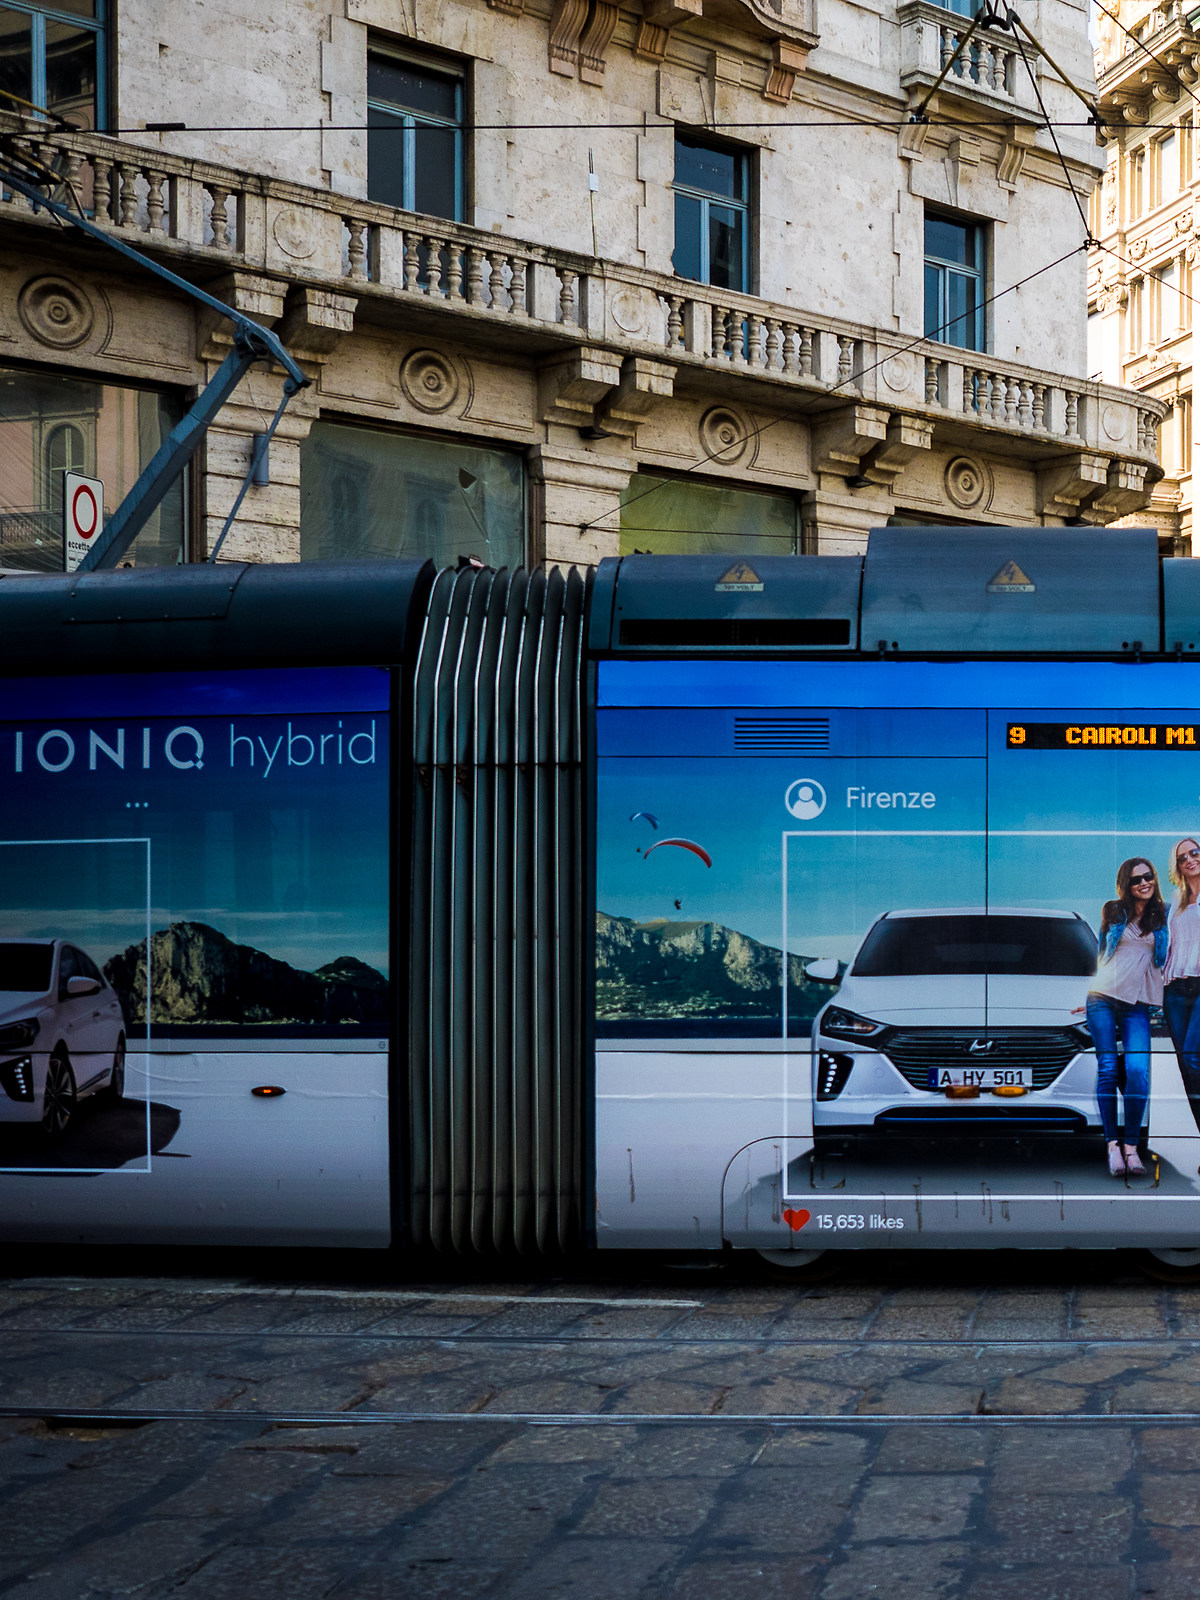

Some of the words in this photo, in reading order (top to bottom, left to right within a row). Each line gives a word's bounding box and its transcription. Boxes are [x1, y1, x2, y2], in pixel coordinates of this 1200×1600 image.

[1009, 727, 1026, 744] 9
[1065, 727, 1157, 744] CAIROLI
[1165, 727, 1197, 744] M1
[15, 726, 205, 772] IONIQ
[230, 720, 375, 778] hybrid
[846, 786, 937, 809] Firenze
[940, 1070, 952, 1085] A
[963, 1070, 985, 1086] HY
[993, 1070, 1025, 1086] 501
[816, 1214, 865, 1232] 15,653
[869, 1214, 905, 1229] likes
